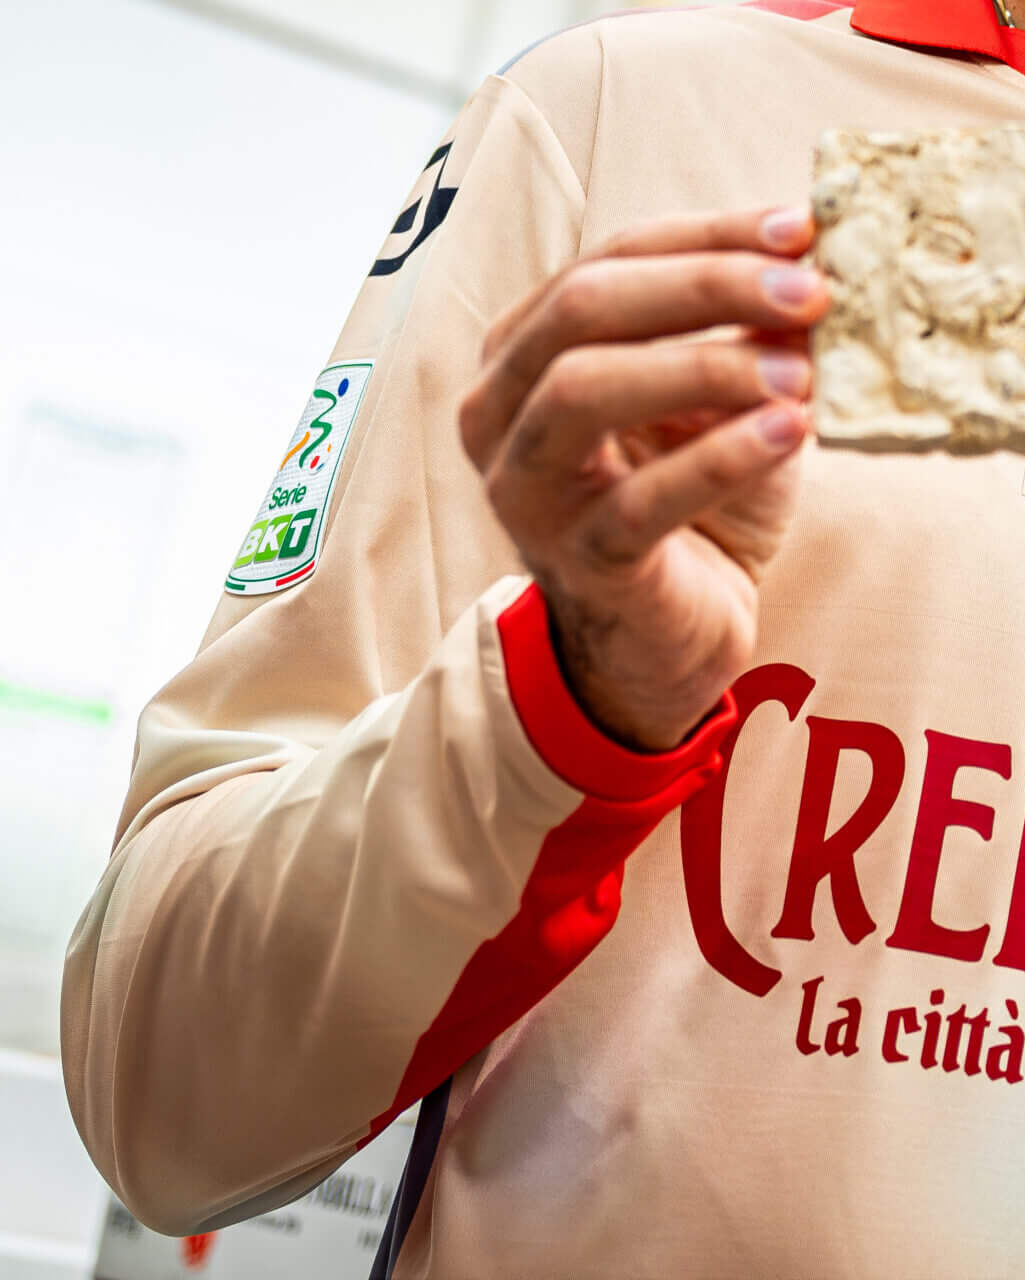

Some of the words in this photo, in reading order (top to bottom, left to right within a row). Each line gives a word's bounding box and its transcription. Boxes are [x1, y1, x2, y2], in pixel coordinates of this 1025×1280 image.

[268, 482, 308, 510] Serie
[235, 516, 313, 560] BKT
[796, 975, 863, 1058] la
[881, 988, 1025, 1085] città
